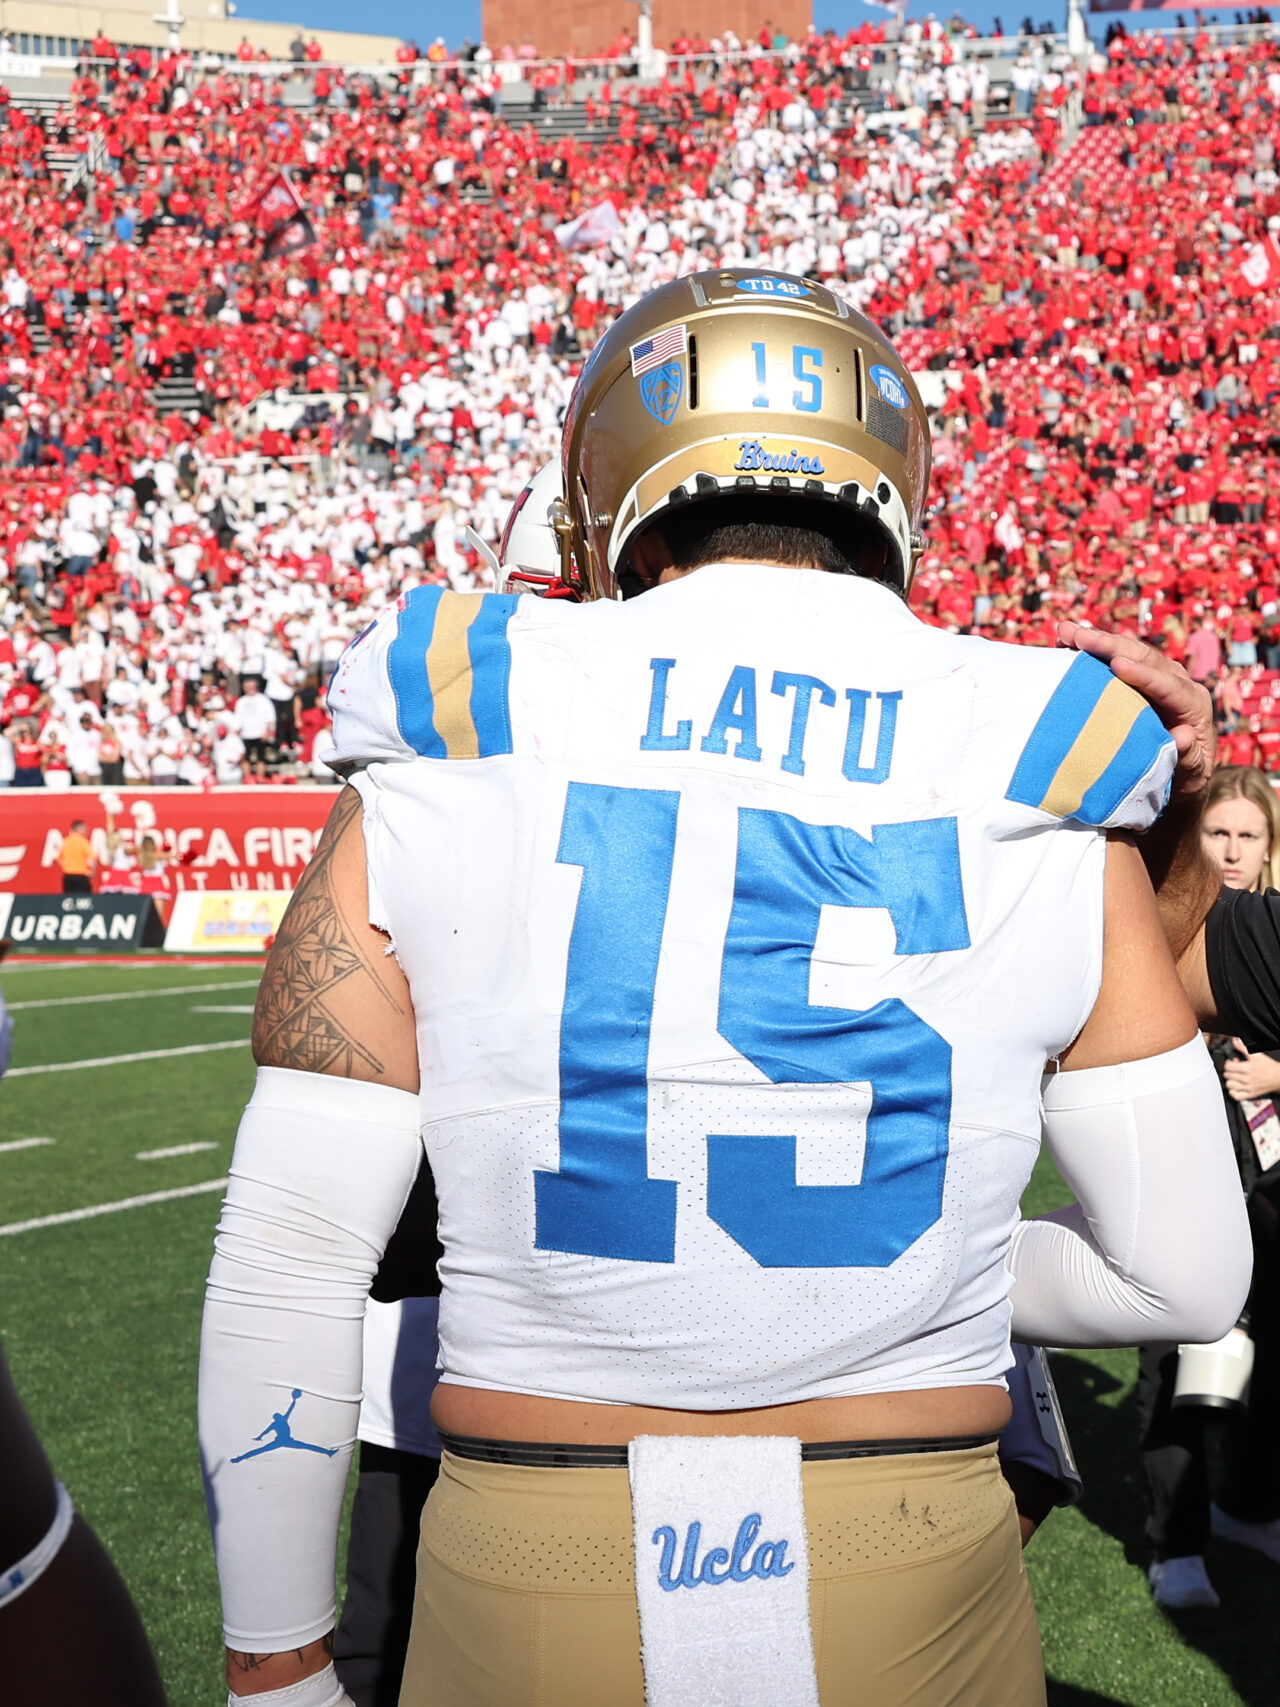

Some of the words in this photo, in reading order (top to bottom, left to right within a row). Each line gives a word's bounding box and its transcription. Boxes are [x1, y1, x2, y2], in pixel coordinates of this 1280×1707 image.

[745, 279, 774, 291] TD
[777, 282, 801, 295] 42
[750, 341, 824, 414] 15
[734, 441, 826, 475] Bruins
[639, 657, 904, 786] LATU
[243, 827, 325, 868] FIR
[10, 913, 137, 942] URBAN
[533, 780, 973, 1269] 15
[651, 1511, 796, 1593] Ucla
